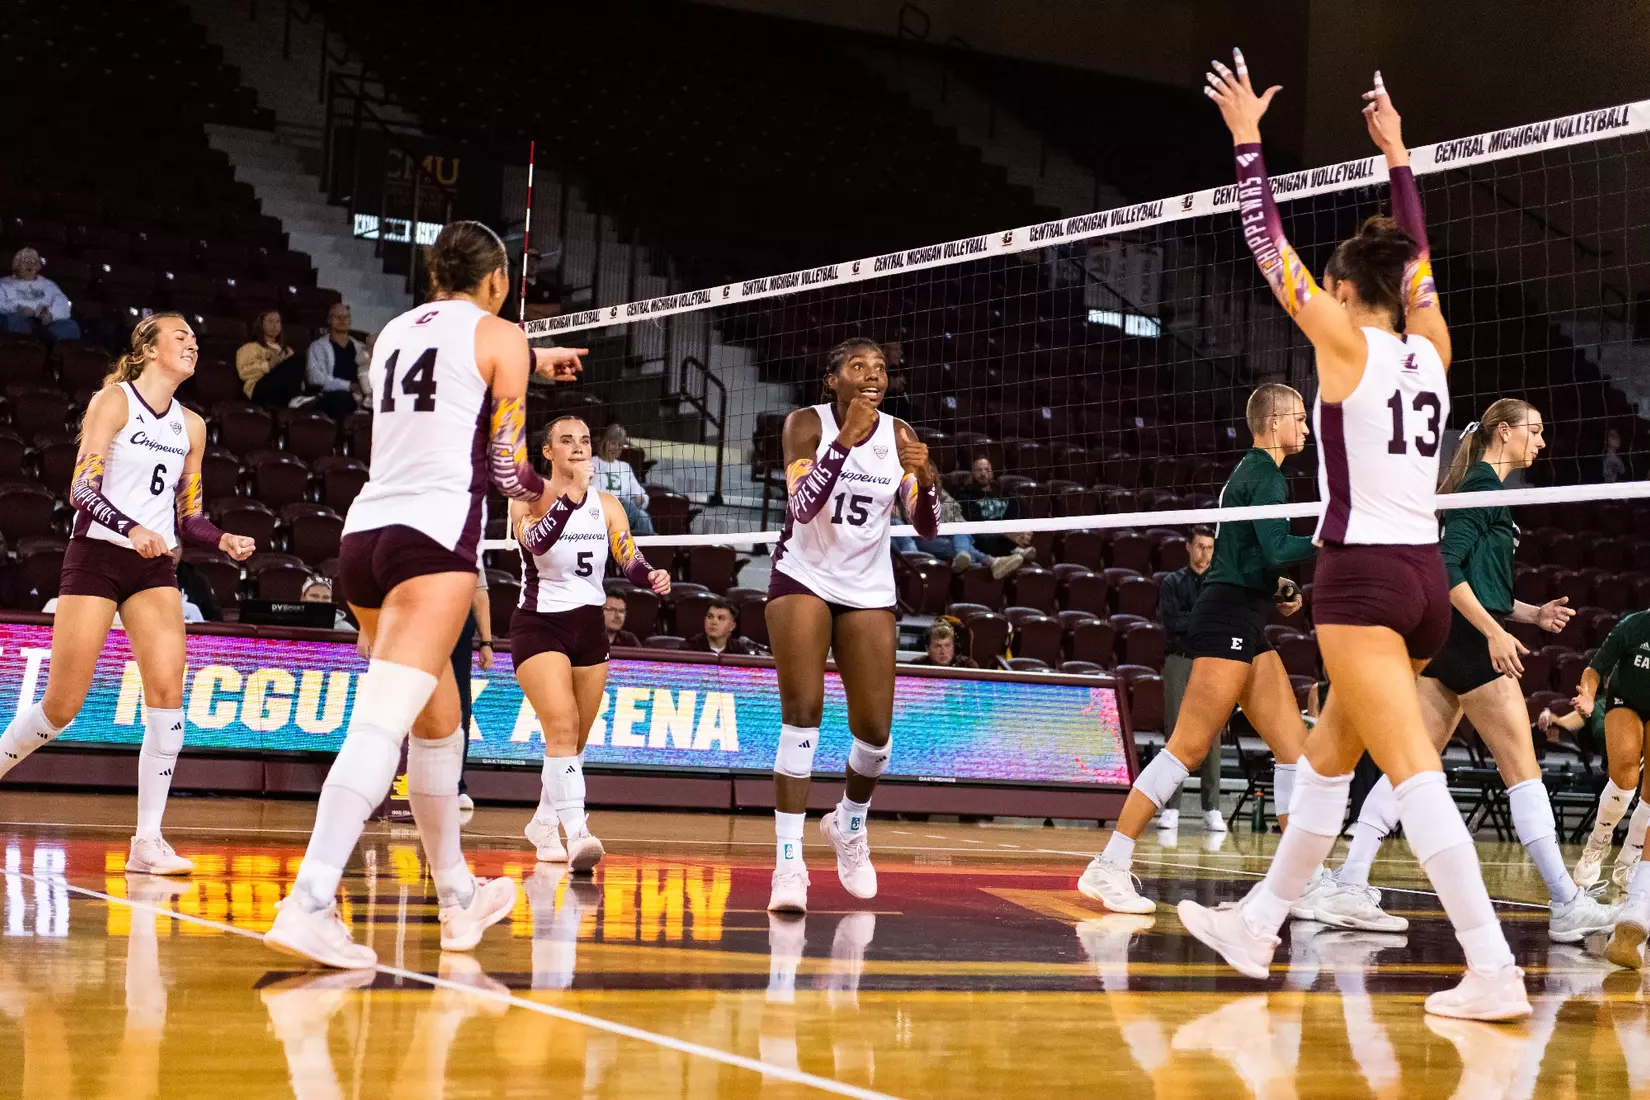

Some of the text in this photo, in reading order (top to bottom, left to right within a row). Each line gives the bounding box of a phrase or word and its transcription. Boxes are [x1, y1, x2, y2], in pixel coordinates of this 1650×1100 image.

[1434, 105, 1630, 164] CENTRAL MICHIGAN VOLLEYBALL
[1212, 158, 1374, 206] CENT CHIGAN VOLLEYBALL
[1029, 221, 1064, 242] CENTRAL
[1066, 214, 1108, 236] MICHIGAN
[1110, 201, 1163, 228] VOLLEYBALL
[1238, 176, 1284, 274] CHIPPEWAS
[873, 252, 904, 273] CENTRAL
[906, 245, 942, 266] MICHIGAN
[943, 236, 988, 259] VOLLEYBALL
[741, 279, 767, 297] CENTRAL
[769, 273, 800, 294] MICHIGAN
[800, 265, 839, 286] VOLLEYBALL
[627, 303, 650, 317] CENTRAL
[651, 298, 678, 313] MICHIGAN
[678, 290, 712, 308] VOLLEYBALL
[528, 320, 547, 333] CENTRAL
[572, 311, 601, 327] VOLLEYBALL
[380, 347, 439, 414] 14
[1387, 388, 1441, 458] 13
[149, 463, 168, 496] 6
[605, 472, 622, 491] E
[838, 469, 892, 485] ippewas
[831, 492, 874, 527] 15
[559, 530, 606, 544] hippewas
[574, 551, 594, 577] 5
[1230, 637, 1243, 650] E
